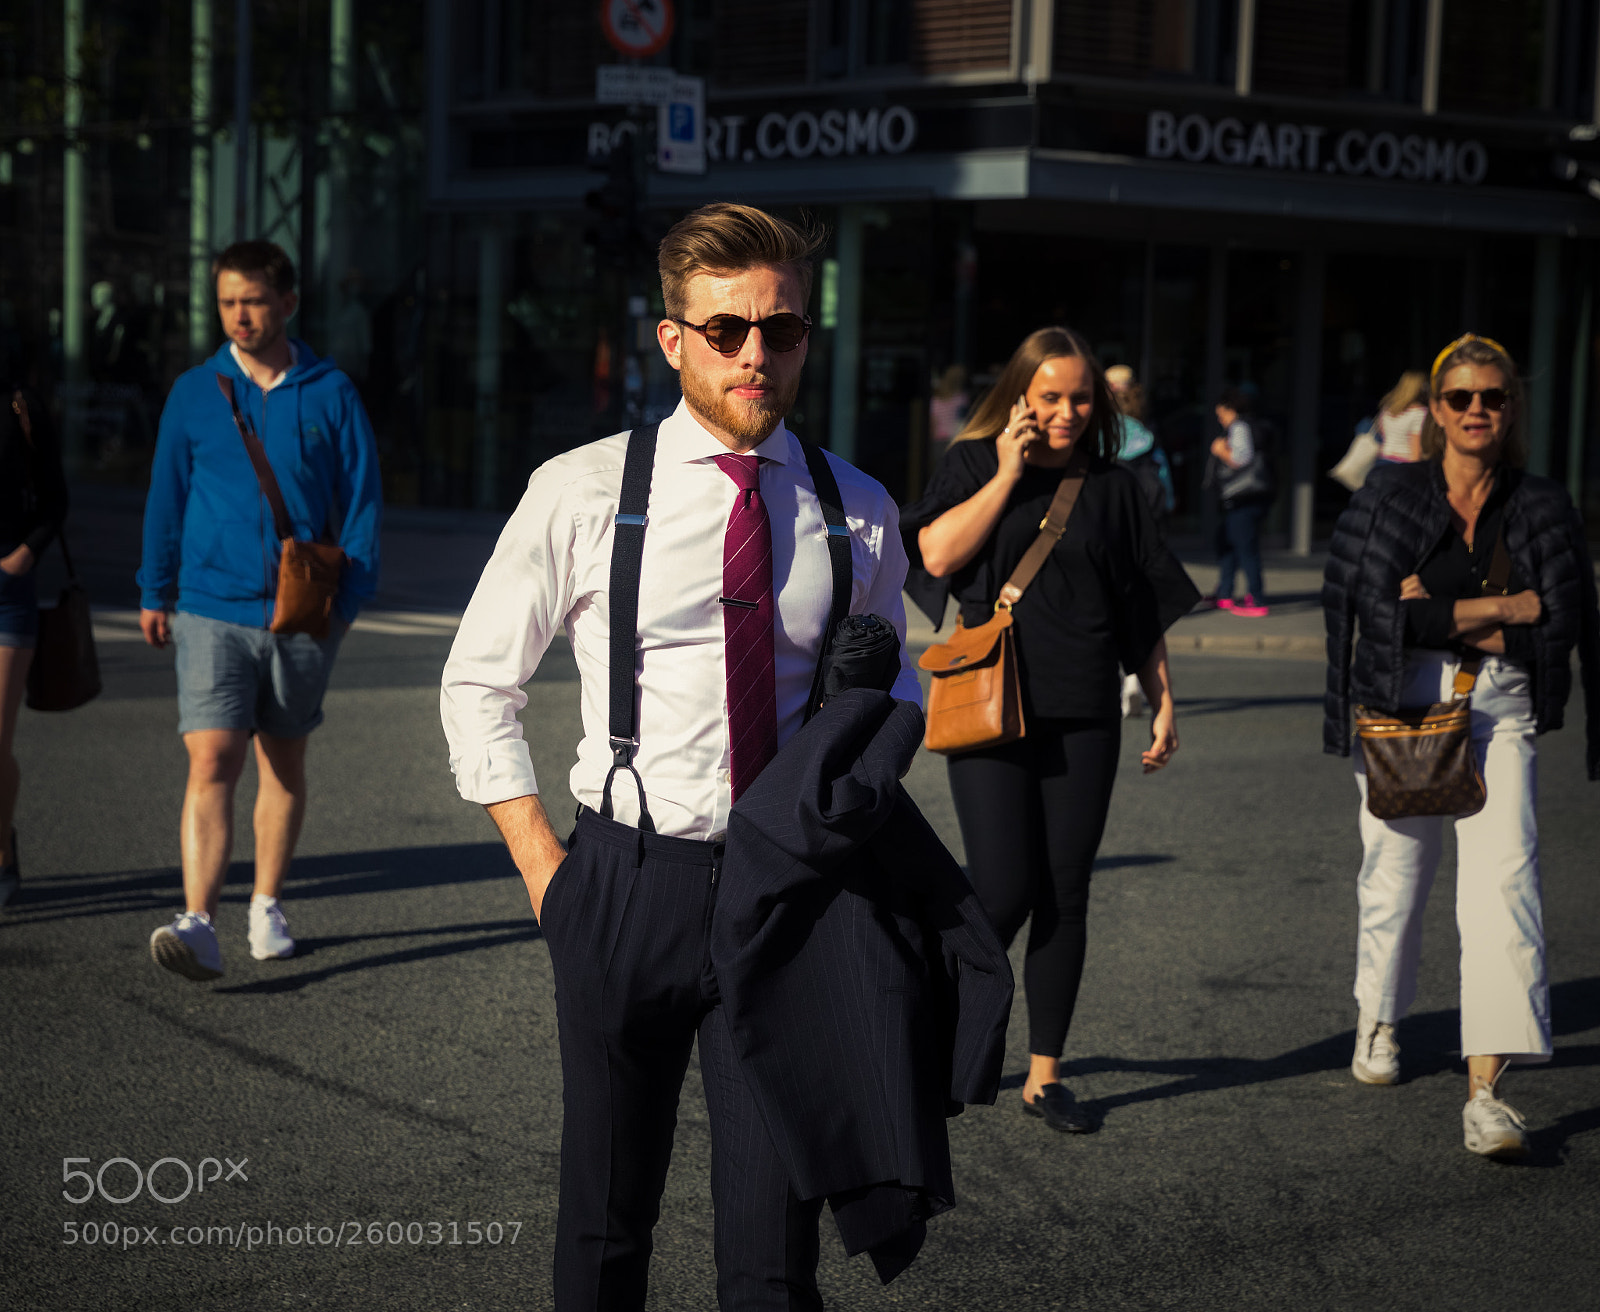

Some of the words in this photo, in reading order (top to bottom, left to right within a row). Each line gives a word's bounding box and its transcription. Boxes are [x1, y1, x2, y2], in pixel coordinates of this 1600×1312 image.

[587, 105, 918, 163] BORT.COSMO
[672, 105, 690, 139] P
[1147, 110, 1487, 184] BOGART.COSMO
